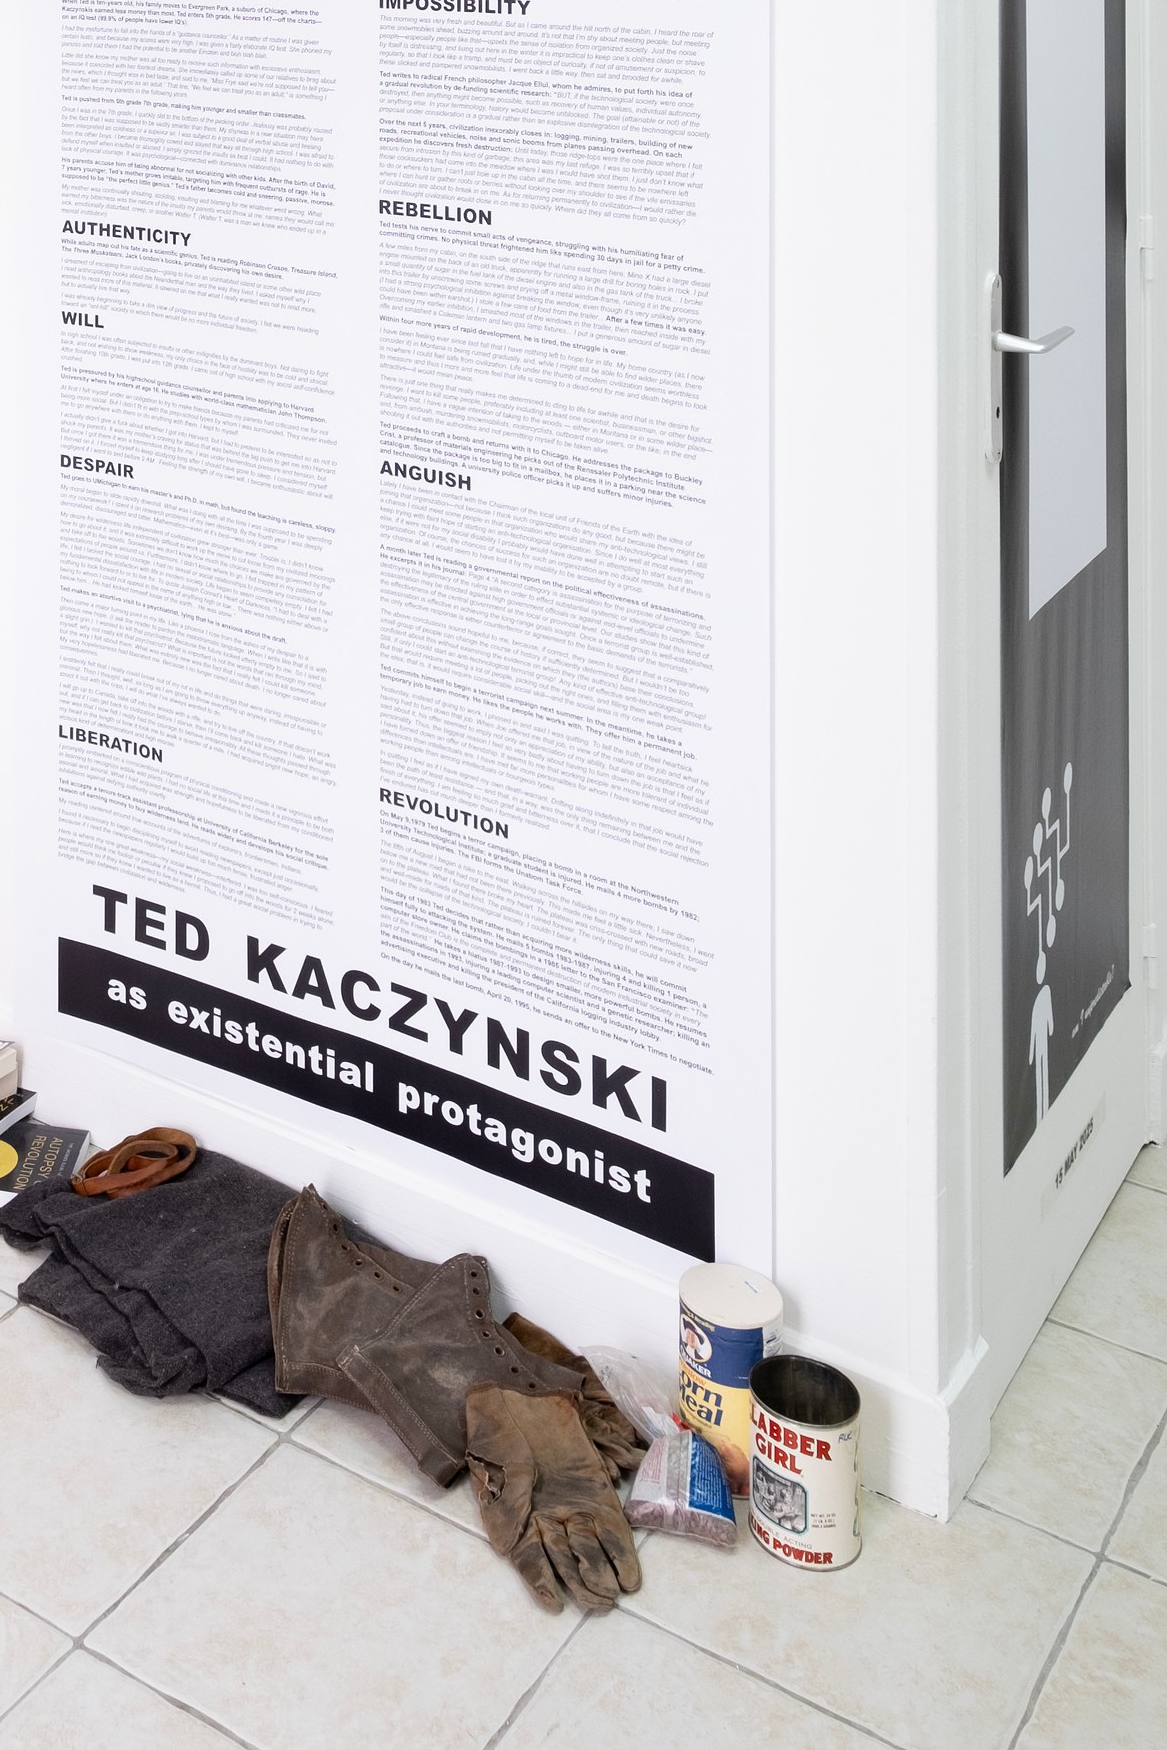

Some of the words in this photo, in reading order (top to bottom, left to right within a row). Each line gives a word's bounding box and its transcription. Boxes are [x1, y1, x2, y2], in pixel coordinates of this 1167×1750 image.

[379, 200, 492, 225] REBELLION
[62, 220, 191, 246] AUTHENTICITY
[61, 311, 104, 328] WILL
[60, 454, 134, 479] DESPAIR
[380, 460, 471, 490] ANGUISH
[59, 725, 162, 763] LIBERATION
[380, 788, 508, 839] REVOLUTION
[93, 884, 210, 962] TED
[247, 936, 667, 1133] KACZYNSKI
[107, 978, 148, 1011] as
[168, 992, 374, 1093] existential
[399, 1079, 652, 1204] protagonist
[13, 1135, 47, 1191] REVOLUTION
[39, 1137, 64, 1179] AUTOPSY
[1055, 1167, 1063, 1189] 15
[1064, 1146, 1078, 1175] MAY
[1079, 1117, 1094, 1151] 2025
[756, 1432, 803, 1475] GIRL
[773, 1540, 833, 1564] POWDER
